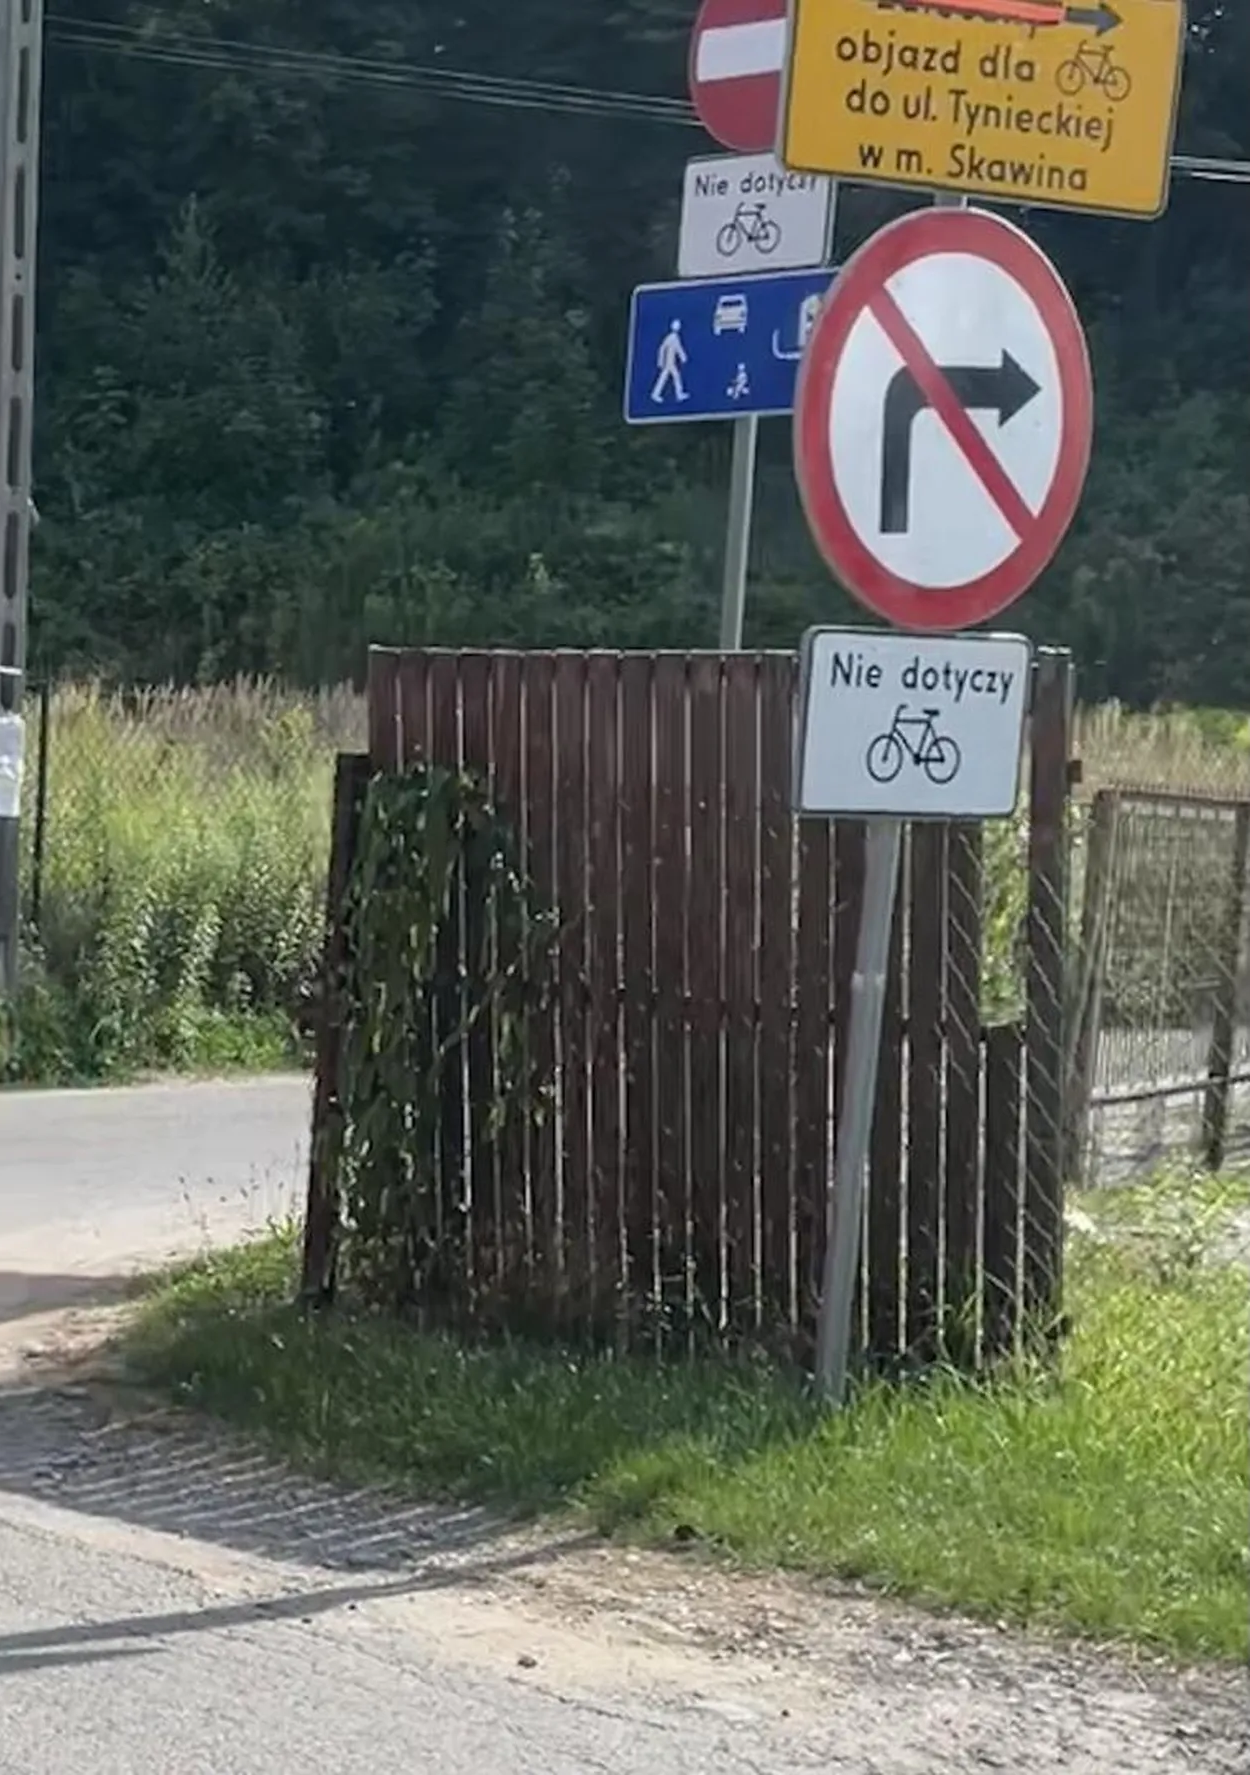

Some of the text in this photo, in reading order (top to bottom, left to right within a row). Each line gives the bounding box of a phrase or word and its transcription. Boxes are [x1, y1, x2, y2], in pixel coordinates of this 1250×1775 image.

[835, 29, 1036, 82] objazd dla
[845, 79, 1115, 152] do ul. Tynieckiej
[694, 174, 729, 197] Nie
[858, 143, 1088, 191] w m. Skawina
[830, 651, 1015, 704] Nie dotyczy
